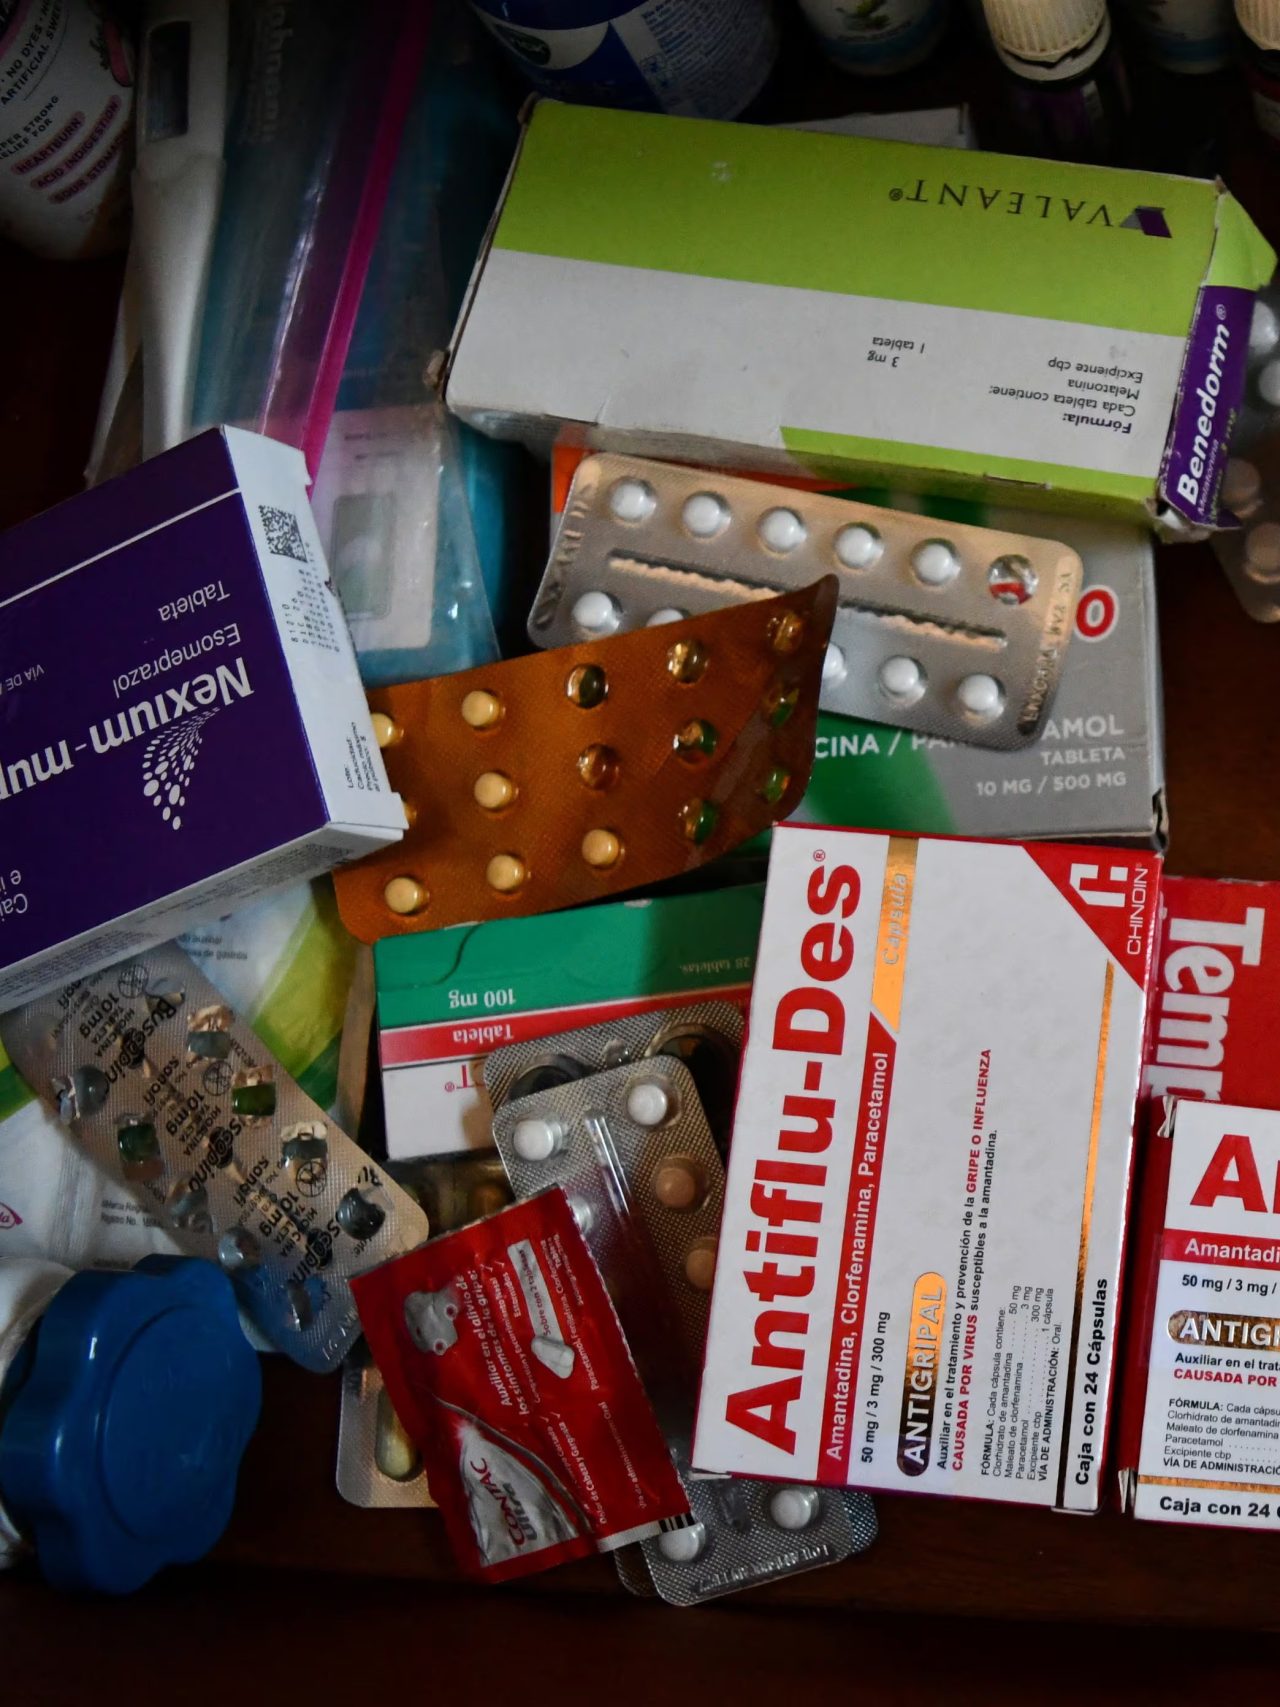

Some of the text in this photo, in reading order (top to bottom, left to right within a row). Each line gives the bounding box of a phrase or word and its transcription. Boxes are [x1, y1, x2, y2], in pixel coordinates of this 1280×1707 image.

[6, 26, 43, 79] NO DYES
[1, 43, 50, 105] ARTIFICIAL
[24, 96, 59, 134] STRONG
[33, 119, 53, 138] FOR
[17, 117, 82, 174] HEARTBURN
[37, 100, 118, 188] ACID INDIGESTION
[55, 179, 87, 202] SOUR
[867, 350, 888, 366] mg
[872, 336, 915, 351] tableta
[1048, 357, 1143, 383] Excipiente cbp
[989, 384, 1136, 416] Cada tableta contiene:
[1068, 378, 1139, 400] Melatonina
[1062, 411, 1132, 434] Fórmula:
[158, 580, 230, 621] Tableta
[112, 623, 241, 699] Esomeprazol
[1041, 747, 1126, 767] TABLETA
[976, 771, 1127, 797] 10 MG 500 MG
[449, 987, 518, 1011] 100 mg
[453, 1022, 514, 1045] Tableta
[973, 1049, 991, 1130] INFLUENZA
[972, 1135, 981, 1145] O
[966, 1149, 981, 1193] GRIPE
[965, 1197, 974, 1207] la
[963, 1210, 973, 1227] de
[826, 1053, 888, 1461] Amantadina, Clorfenamina, Paracetamol
[955, 1230, 972, 1298] prevención
[952, 1130, 997, 1471] CAUSADA POR VIRUS susceptibles a la amantadina.
[538, 1313, 551, 1336] Sobre
[947, 1313, 961, 1384] tratamiento
[485, 1359, 513, 1407] Auxiliar
[862, 1311, 890, 1463] 50 mg 3 mg 300 mg
[903, 1286, 943, 1465] ANTIGRIPAL
[1075, 1278, 1108, 1485] Caja con 24 Cápsulas
[945, 1387, 954, 1401] el
[944, 1404, 952, 1418] en
[937, 1421, 950, 1469] Auxiliar
[1160, 1496, 1201, 1514] Caja
[1207, 1502, 1242, 1516] con
[1248, 1503, 1270, 1517] 24
